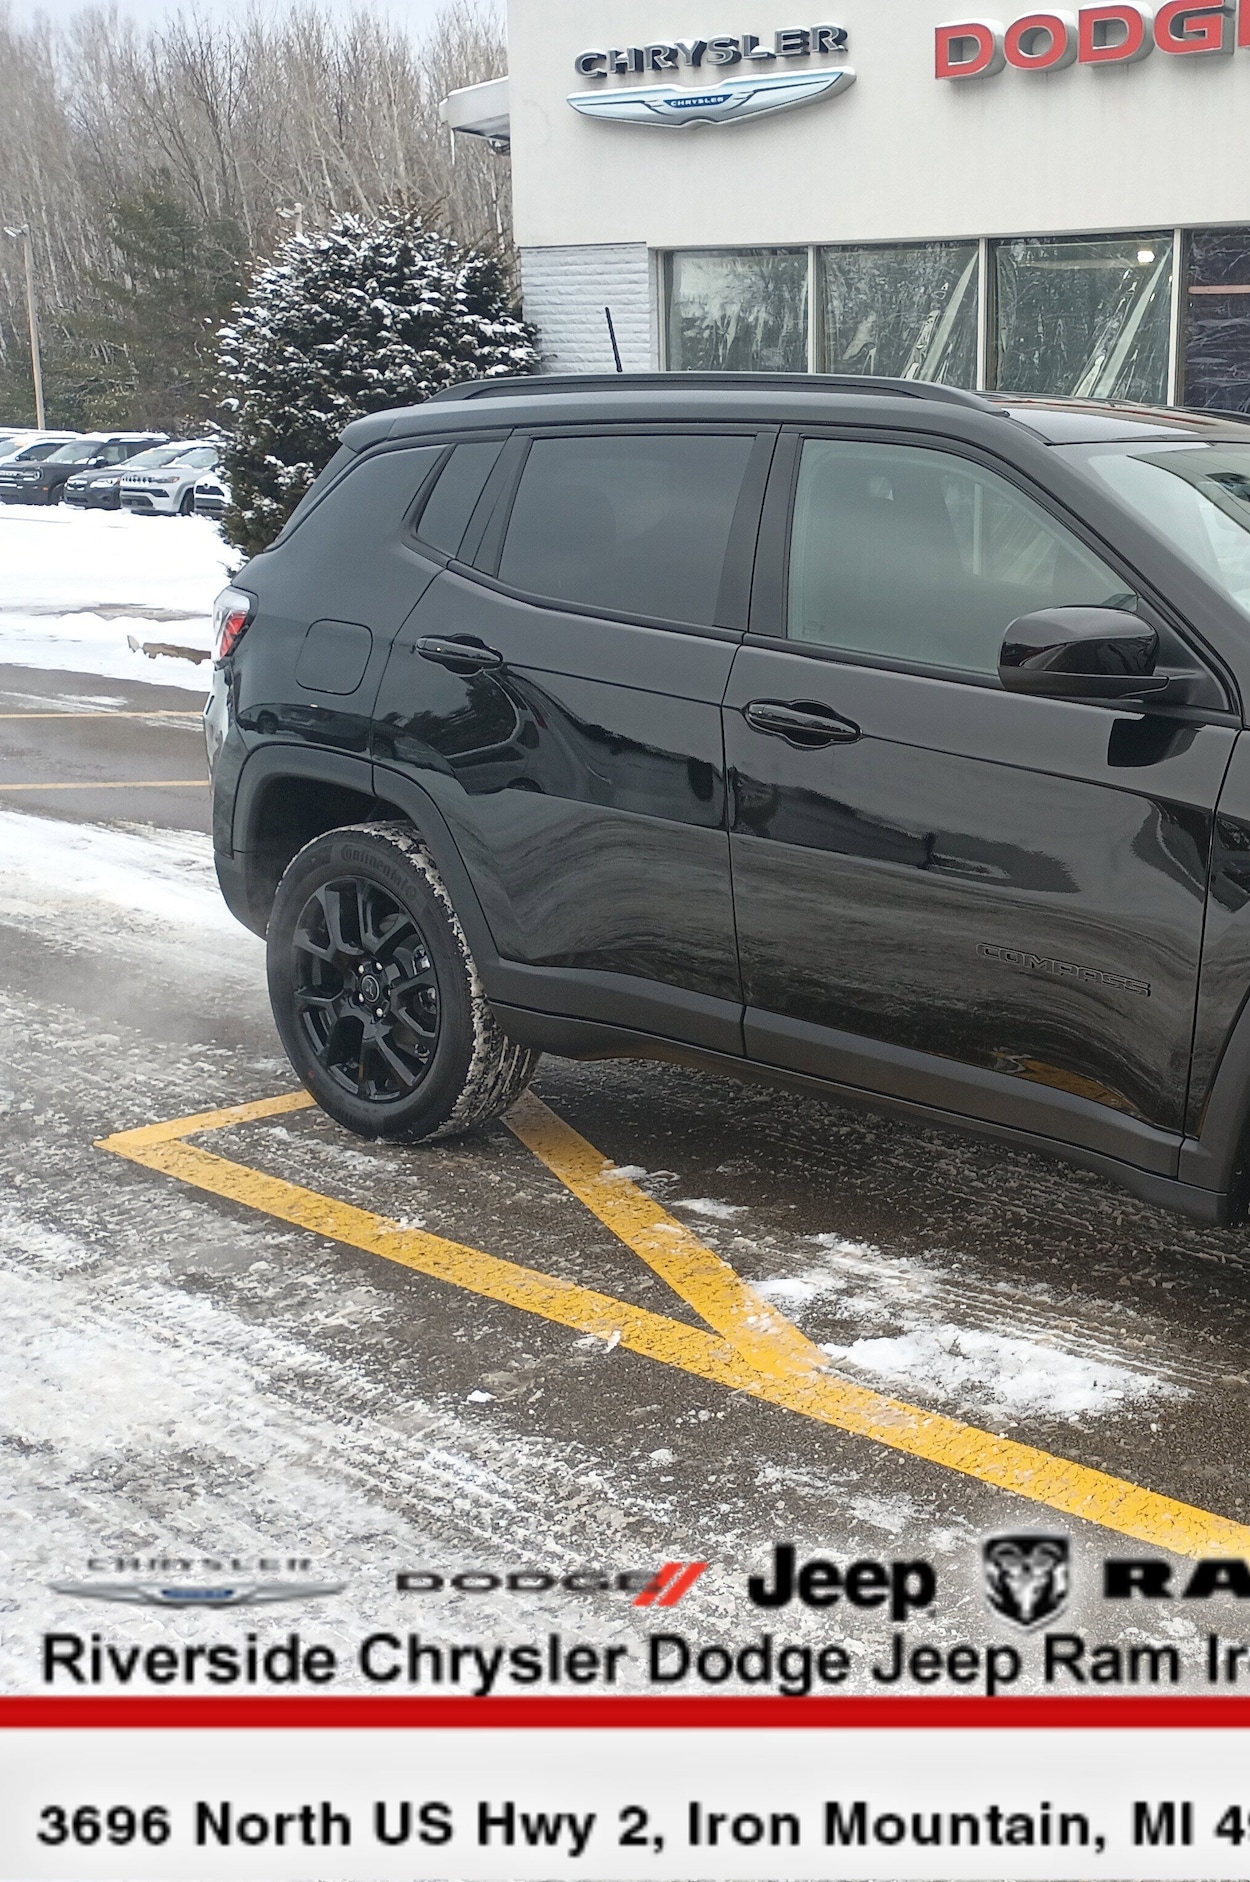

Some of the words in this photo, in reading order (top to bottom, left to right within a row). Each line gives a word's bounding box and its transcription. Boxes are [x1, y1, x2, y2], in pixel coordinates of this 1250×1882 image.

[574, 22, 848, 79] CHRYSLER
[670, 96, 724, 107] CHRYSLER
[976, 943, 1151, 998] COMPASS
